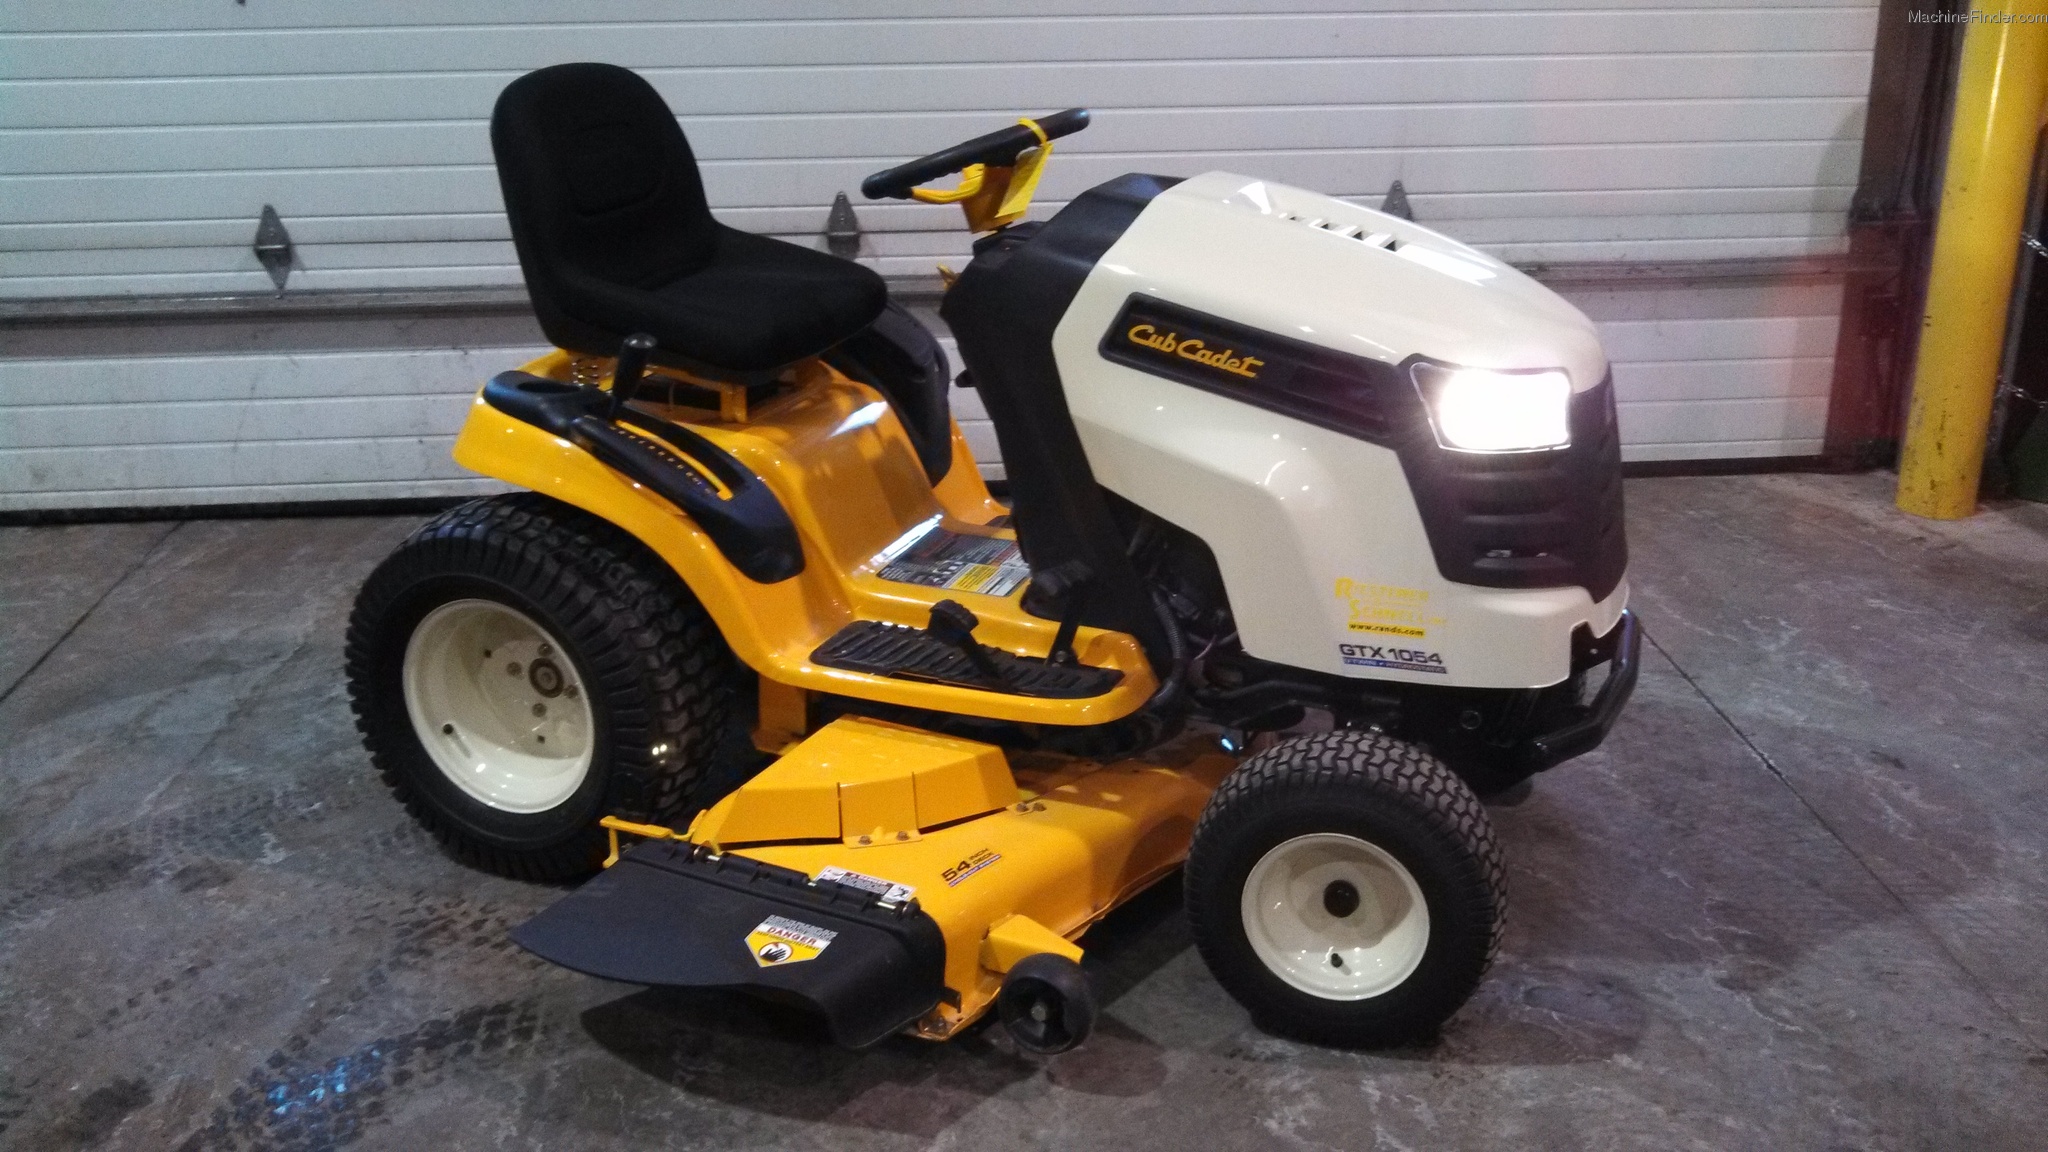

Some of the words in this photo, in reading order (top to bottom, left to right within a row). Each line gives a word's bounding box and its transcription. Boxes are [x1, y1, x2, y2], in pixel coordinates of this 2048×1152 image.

[1127, 324, 1177, 353] Cub
[1175, 339, 1265, 378] Cadet
[1338, 643, 1386, 660] GTX
[1387, 647, 1443, 665] 1054
[941, 860, 971, 882] 54
[767, 926, 817, 946] DANGER
